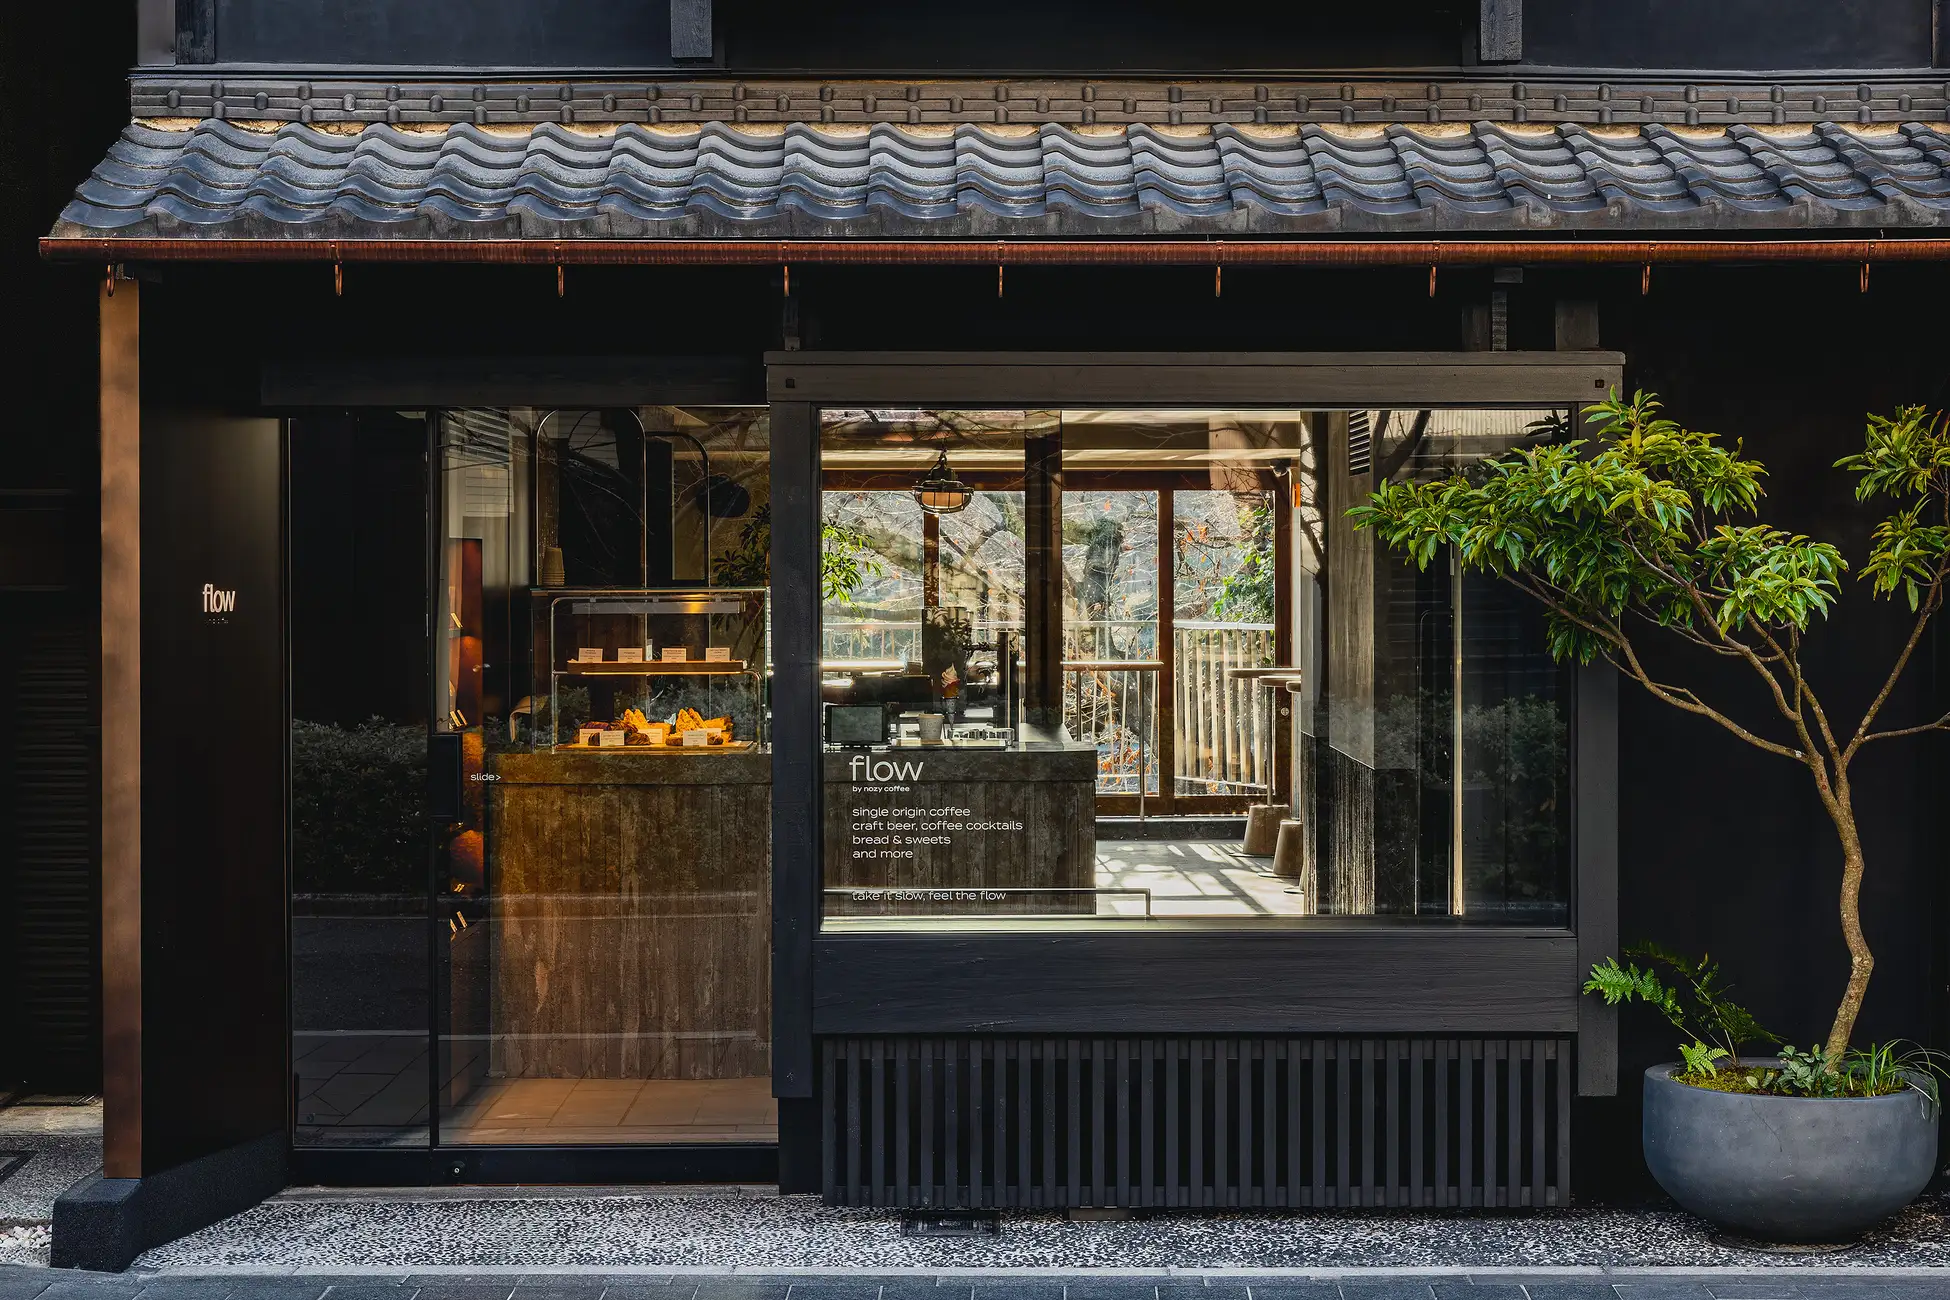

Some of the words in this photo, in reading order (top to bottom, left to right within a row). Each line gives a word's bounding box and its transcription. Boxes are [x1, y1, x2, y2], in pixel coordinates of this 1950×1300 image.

[202, 583, 236, 613] flow
[849, 755, 924, 782] flow
[852, 785, 862, 793] by
[852, 806, 889, 819] single
[892, 806, 926, 819] origin
[929, 806, 971, 817] coffee
[852, 820, 883, 831] craft
[887, 820, 918, 832] beer,
[921, 820, 963, 831] coffee
[966, 820, 1023, 831] cocktails
[852, 835, 890, 845] bread
[892, 835, 903, 845] &
[905, 835, 952, 845] sweets
[852, 849, 877, 859] and
[880, 850, 914, 859] more
[852, 890, 880, 901] take
[883, 890, 892, 901] it
[895, 890, 926, 902] slow,
[928, 890, 953, 901] feel
[956, 890, 977, 901] the
[980, 890, 1007, 901] flow
